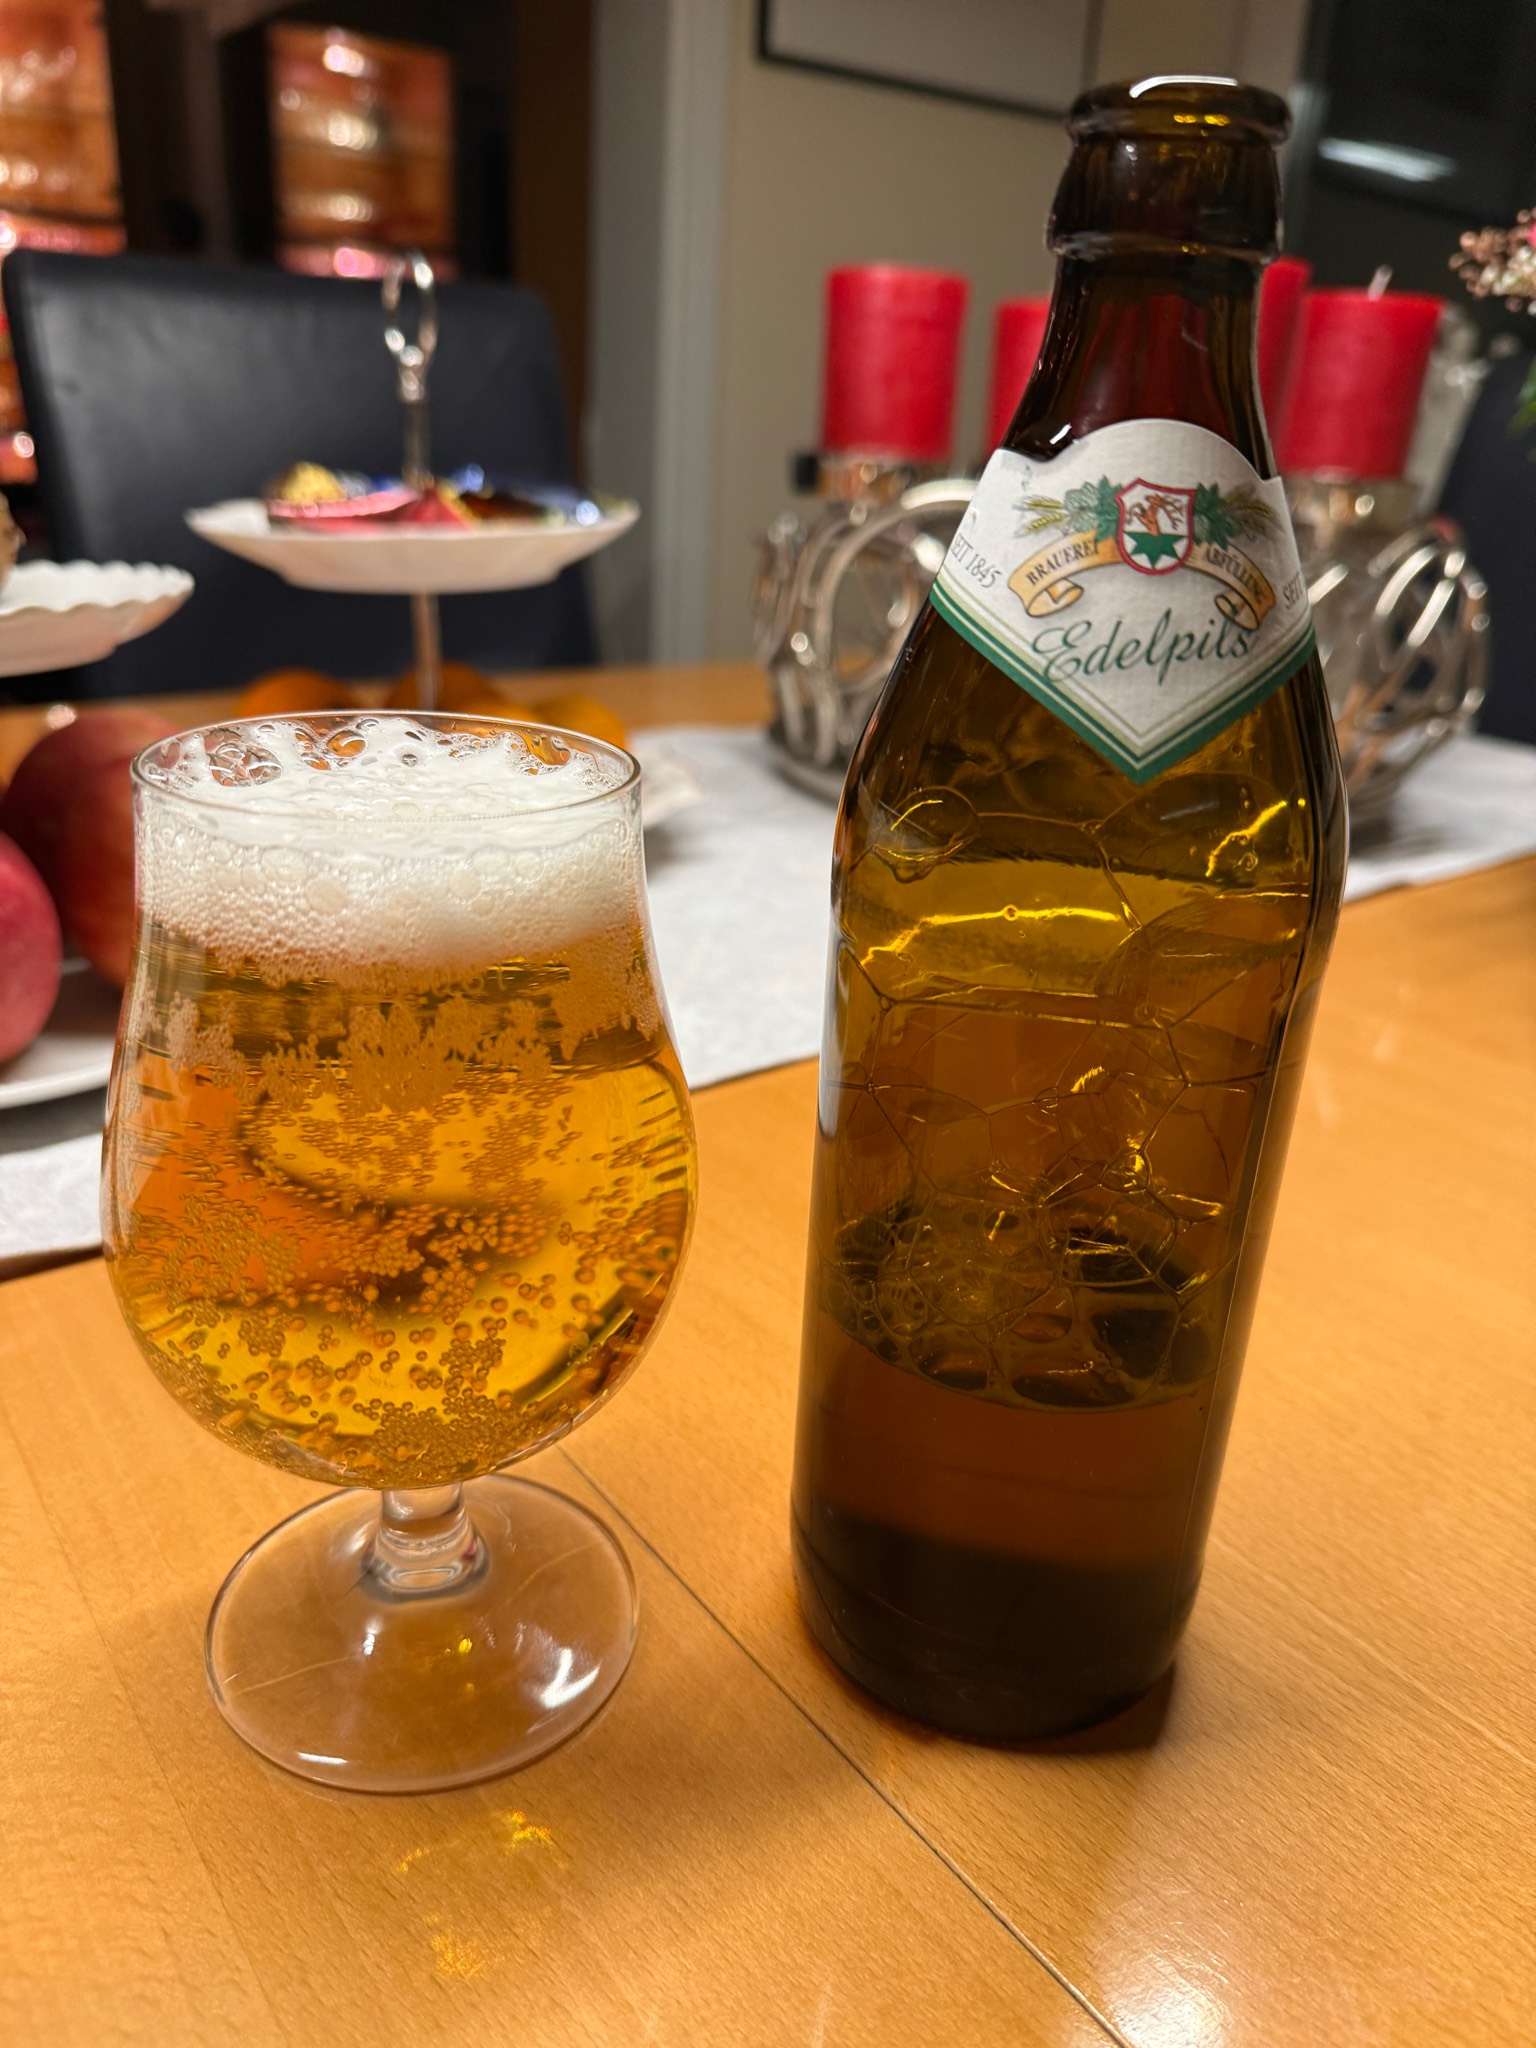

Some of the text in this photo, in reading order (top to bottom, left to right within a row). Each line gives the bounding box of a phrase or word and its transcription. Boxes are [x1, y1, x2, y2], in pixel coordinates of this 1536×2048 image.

[965, 553, 1003, 588] 1845
[1026, 539, 1099, 586] BRAUEREI
[1031, 606, 1253, 686] Edelpils
